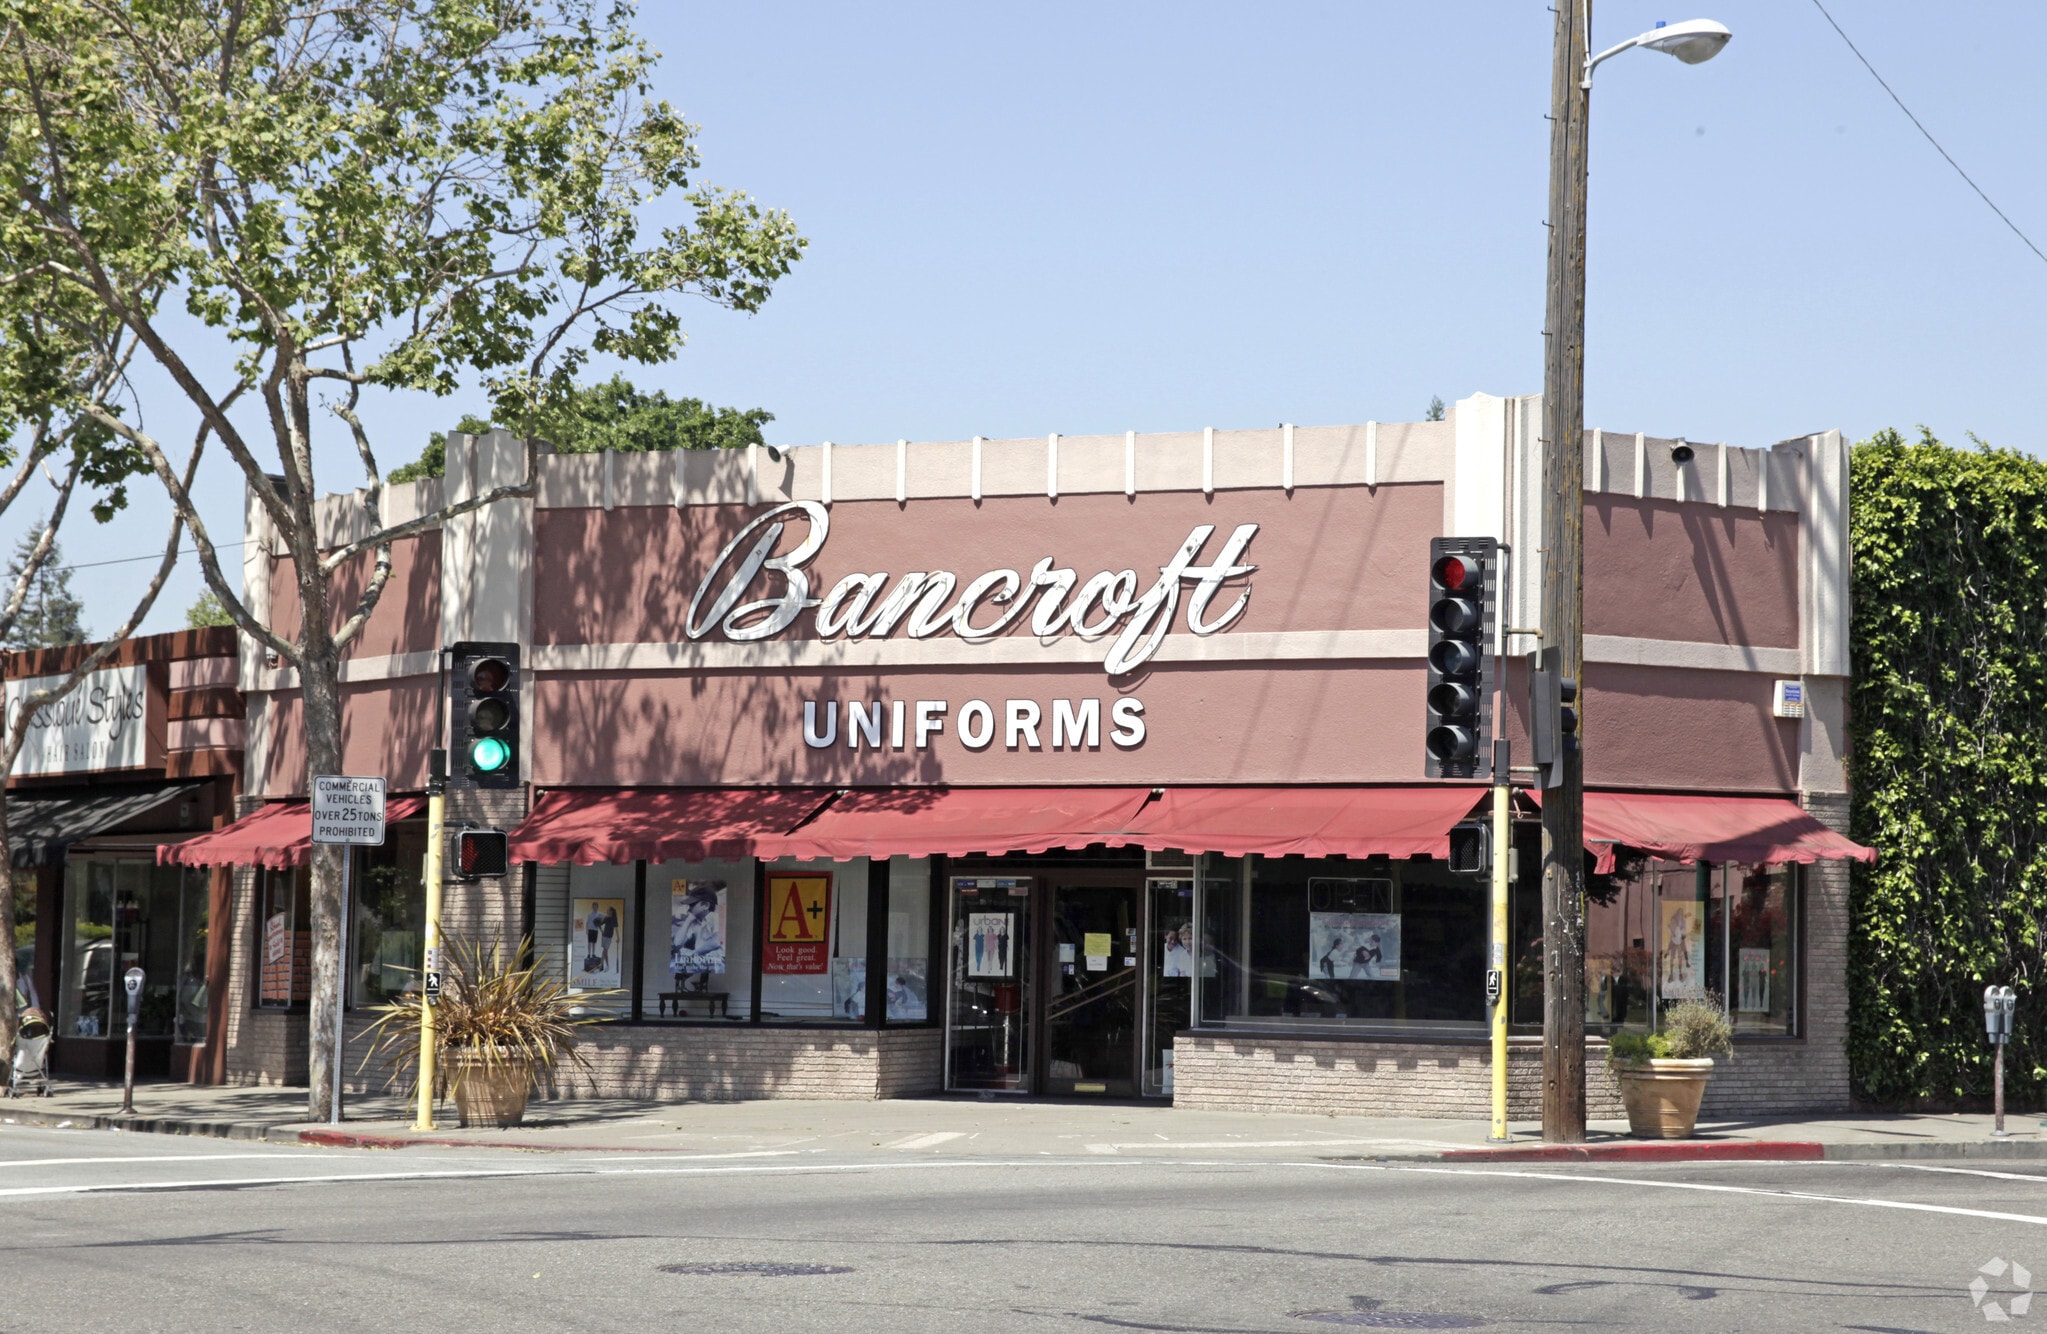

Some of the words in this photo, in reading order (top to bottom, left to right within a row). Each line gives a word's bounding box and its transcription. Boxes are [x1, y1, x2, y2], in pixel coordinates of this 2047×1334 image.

[685, 499, 1260, 676] Bancroft
[8, 697, 81, 734] Cssique
[87, 686, 143, 741] Styles
[803, 698, 1147, 749] UNIFORMS
[73, 740, 105, 761] SALON
[319, 781, 380, 792] COMMERCIAL
[326, 793, 372, 805] VEHICLES
[315, 810, 340, 820] OVER
[342, 807, 357, 821] 25
[357, 811, 383, 821] TONS
[319, 826, 375, 837] PROHIBITED
[1311, 881, 1390, 911] OPEN
[772, 881, 823, 939] A+
[776, 946, 794, 954] Look
